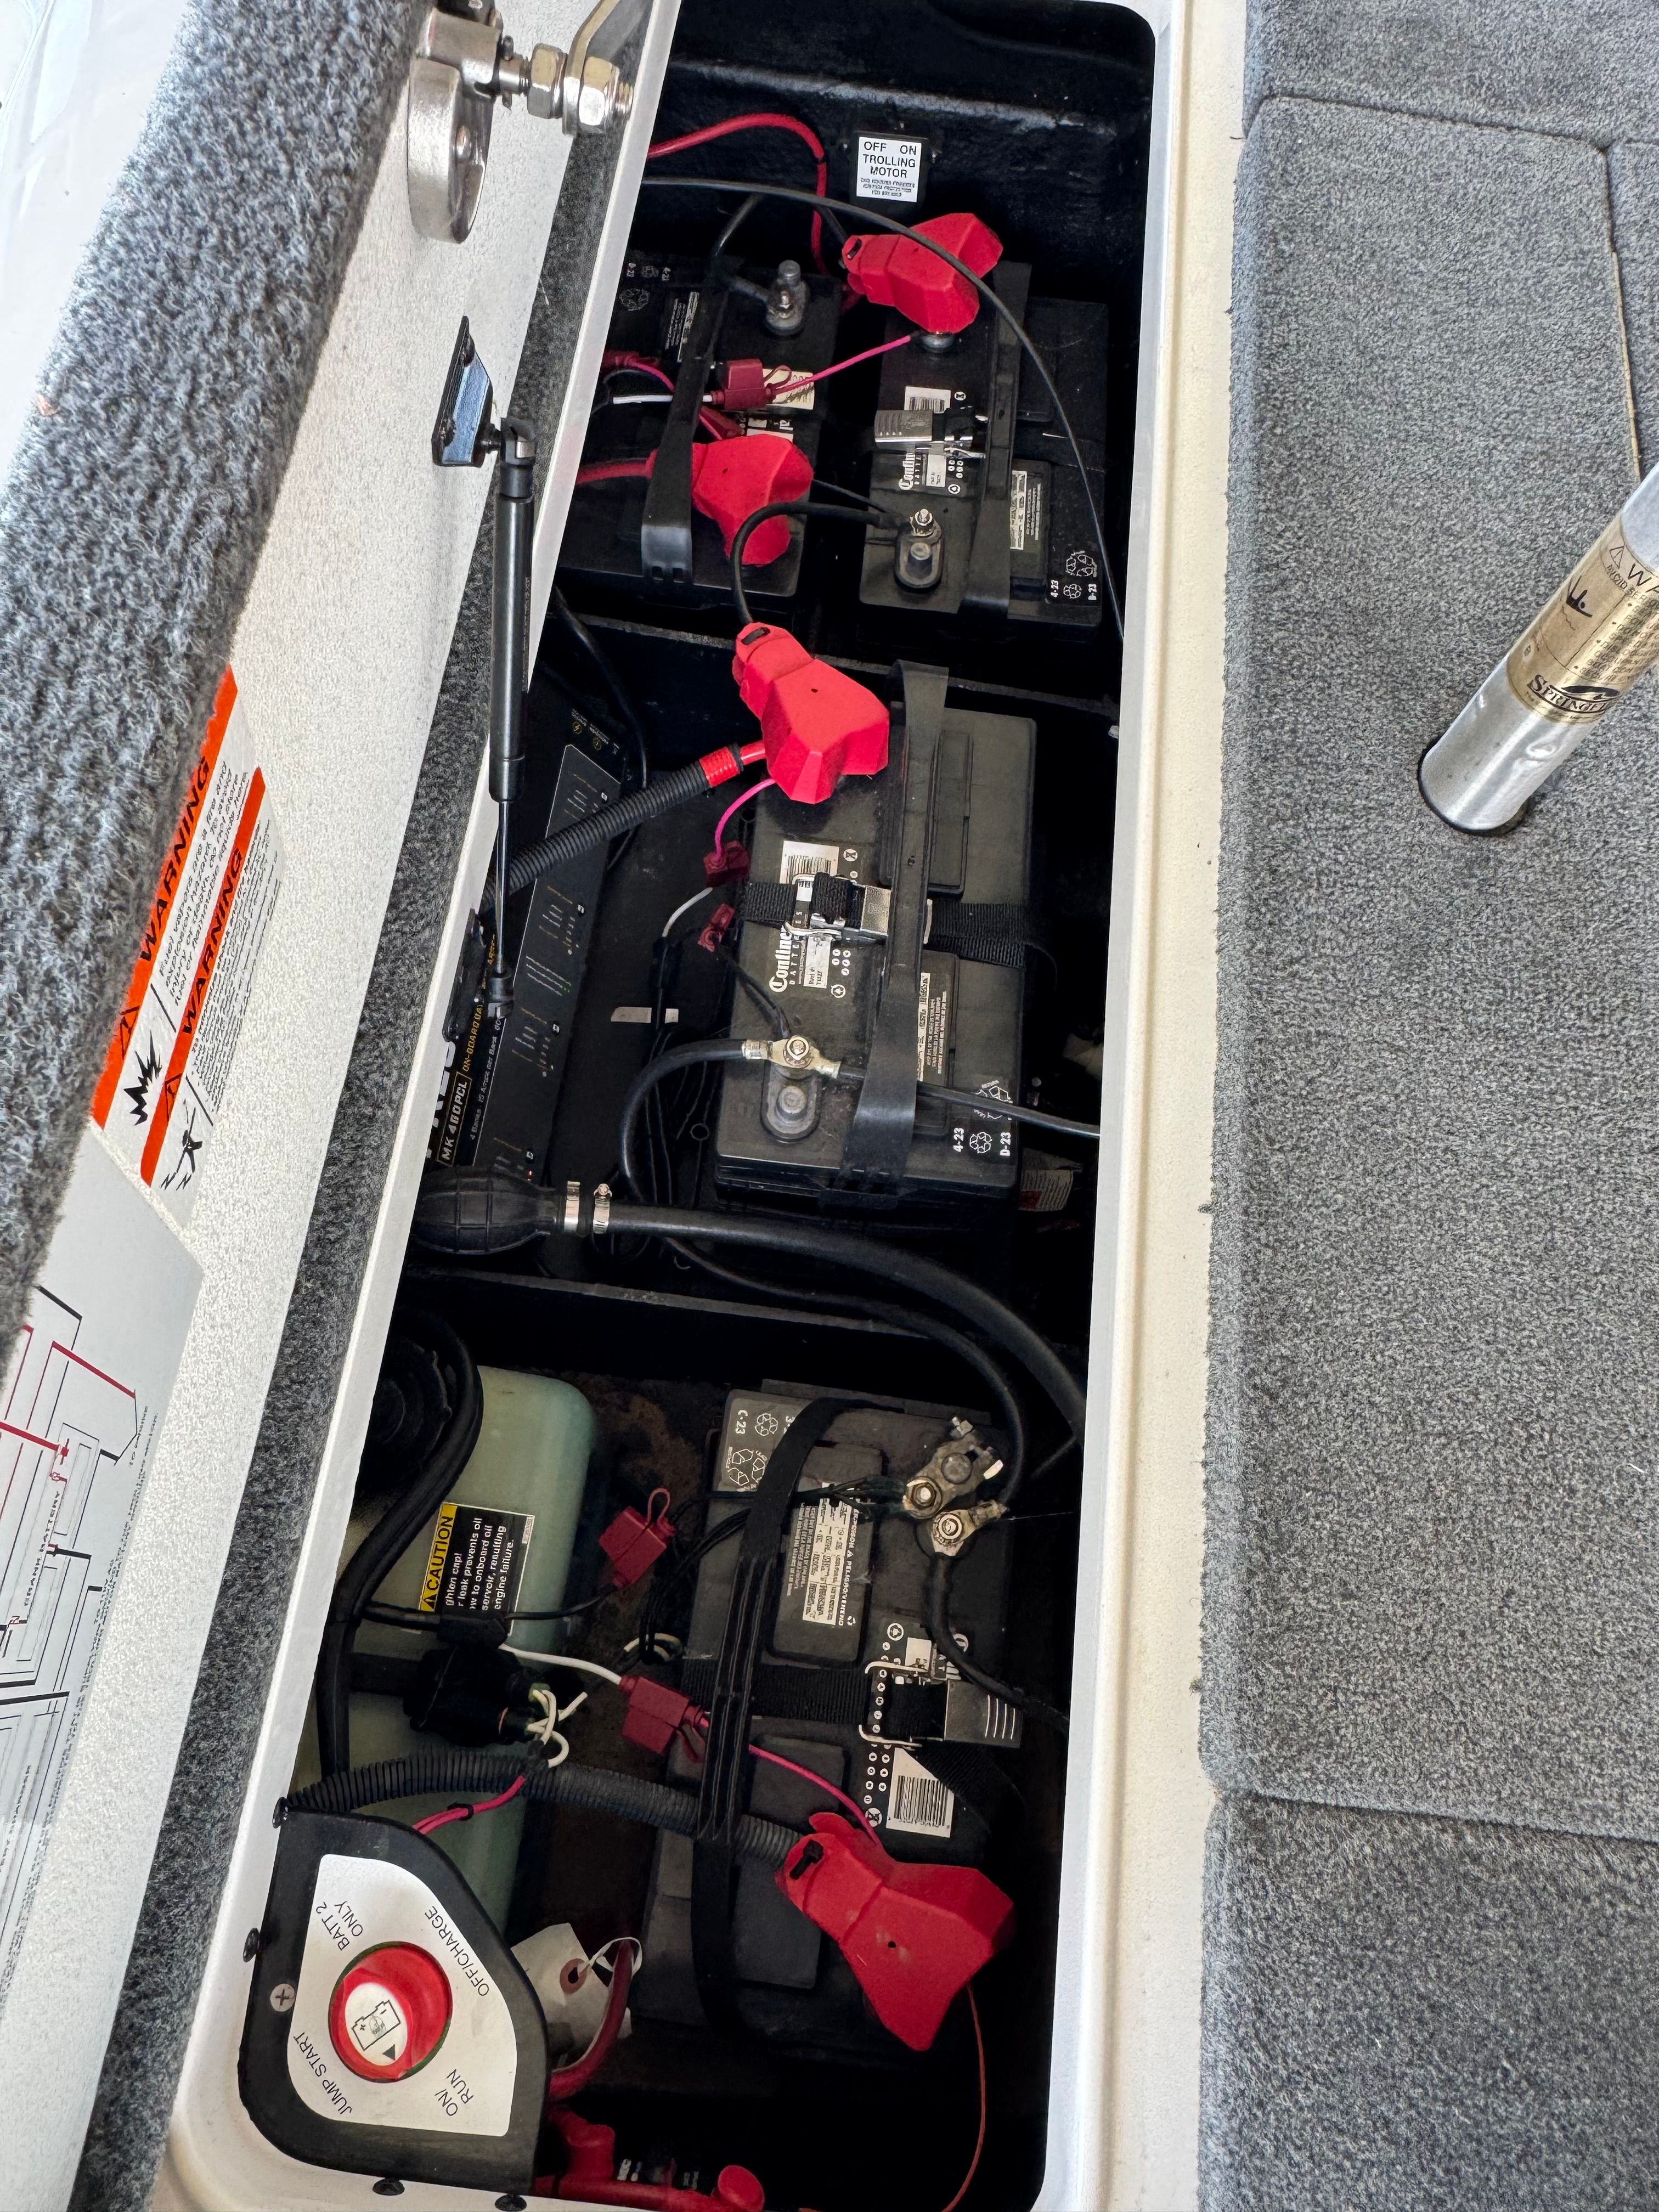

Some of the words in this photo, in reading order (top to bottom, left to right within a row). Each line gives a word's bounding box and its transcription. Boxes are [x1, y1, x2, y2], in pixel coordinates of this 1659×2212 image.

[863, 154, 915, 167] TROLLING
[864, 142, 887, 151] OFF
[900, 145, 917, 155] ON
[870, 166, 907, 178] MOTOR
[140, 755, 209, 962] WARNING
[183, 848, 242, 1034] WARNING
[441, 1137, 455, 1160] MK
[953, 1127, 964, 1153] 4-23
[1000, 1132, 1011, 1157] D-23
[735, 1409, 748, 1435] C-23
[427, 1516, 454, 1591] CAUTION
[458, 1579, 469, 1599] leak
[465, 1533, 478, 1576] prevents
[473, 1518, 482, 1530] oil
[472, 1585, 480, 1595] to
[476, 1540, 489, 1582] onboard
[484, 1525, 493, 1538] oil
[490, 1526, 506, 1570] resulting
[494, 1576, 506, 1610] engine
[315, 1901, 327, 1914] 2
[334, 1900, 363, 1937] ONLY
[321, 1914, 350, 1951] BATT
[425, 1905, 489, 1996] OFF/CHARGE
[293, 2032, 326, 2076] START
[323, 2079, 352, 2115] JUMP
[435, 2089, 458, 2116] ON/
[447, 2069, 474, 2104] RUN
